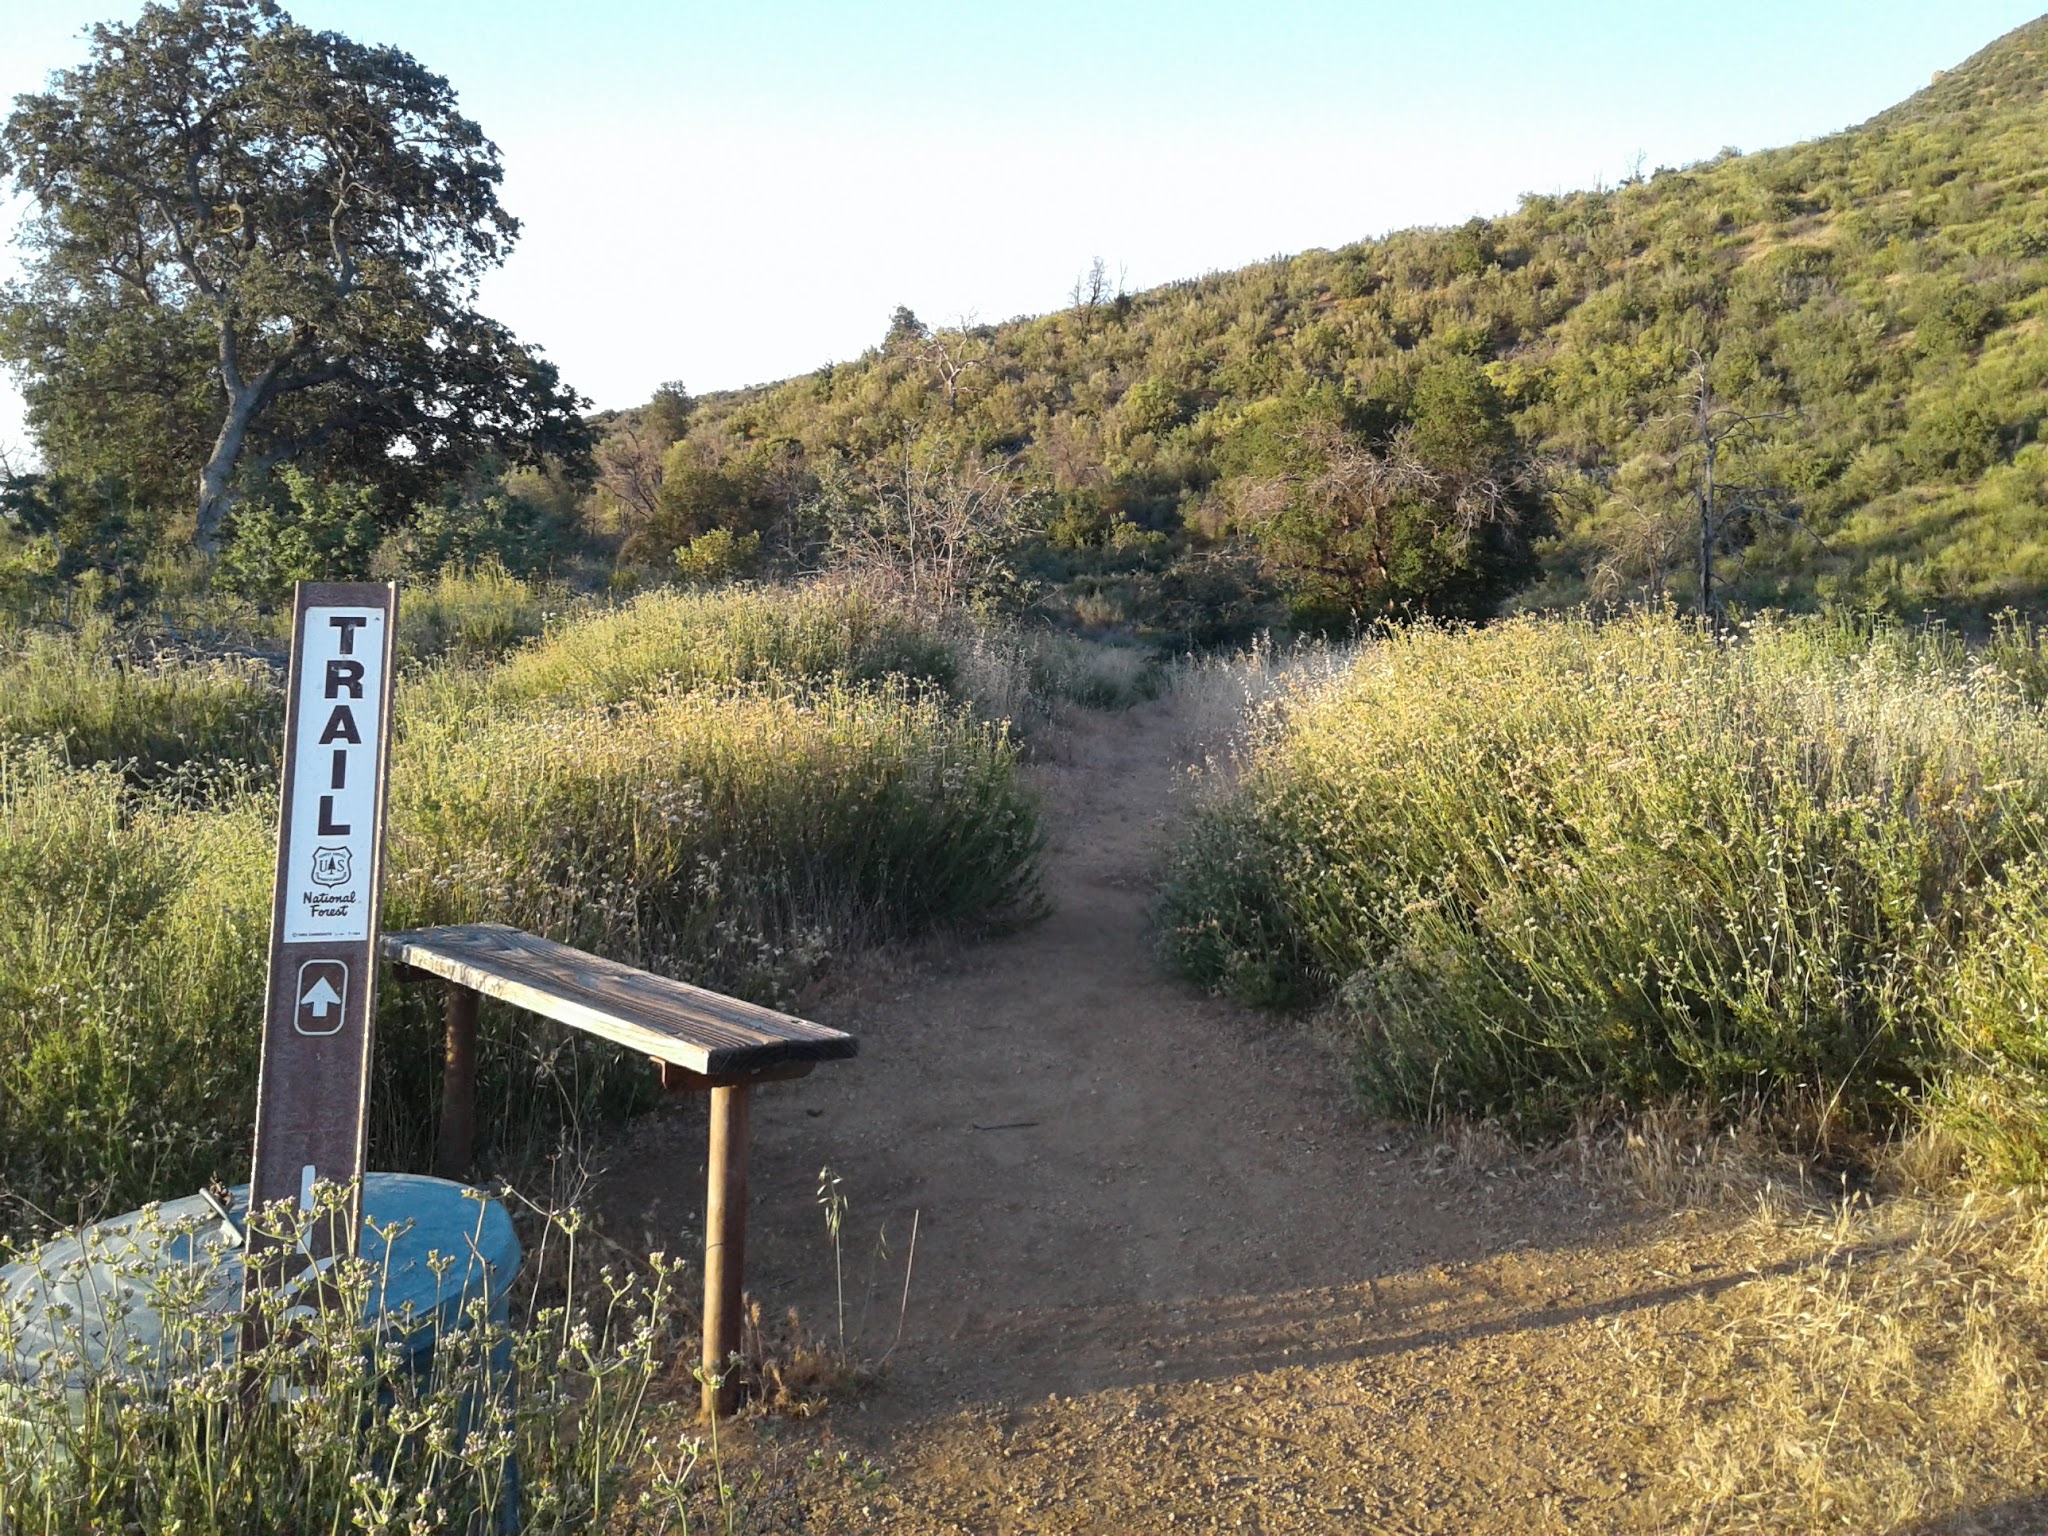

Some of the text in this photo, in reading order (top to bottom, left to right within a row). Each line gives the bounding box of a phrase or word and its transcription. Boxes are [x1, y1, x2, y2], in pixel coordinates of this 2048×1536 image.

[317, 616, 367, 836] TRAIL
[302, 890, 357, 904] National
[309, 904, 349, 917] Forest
